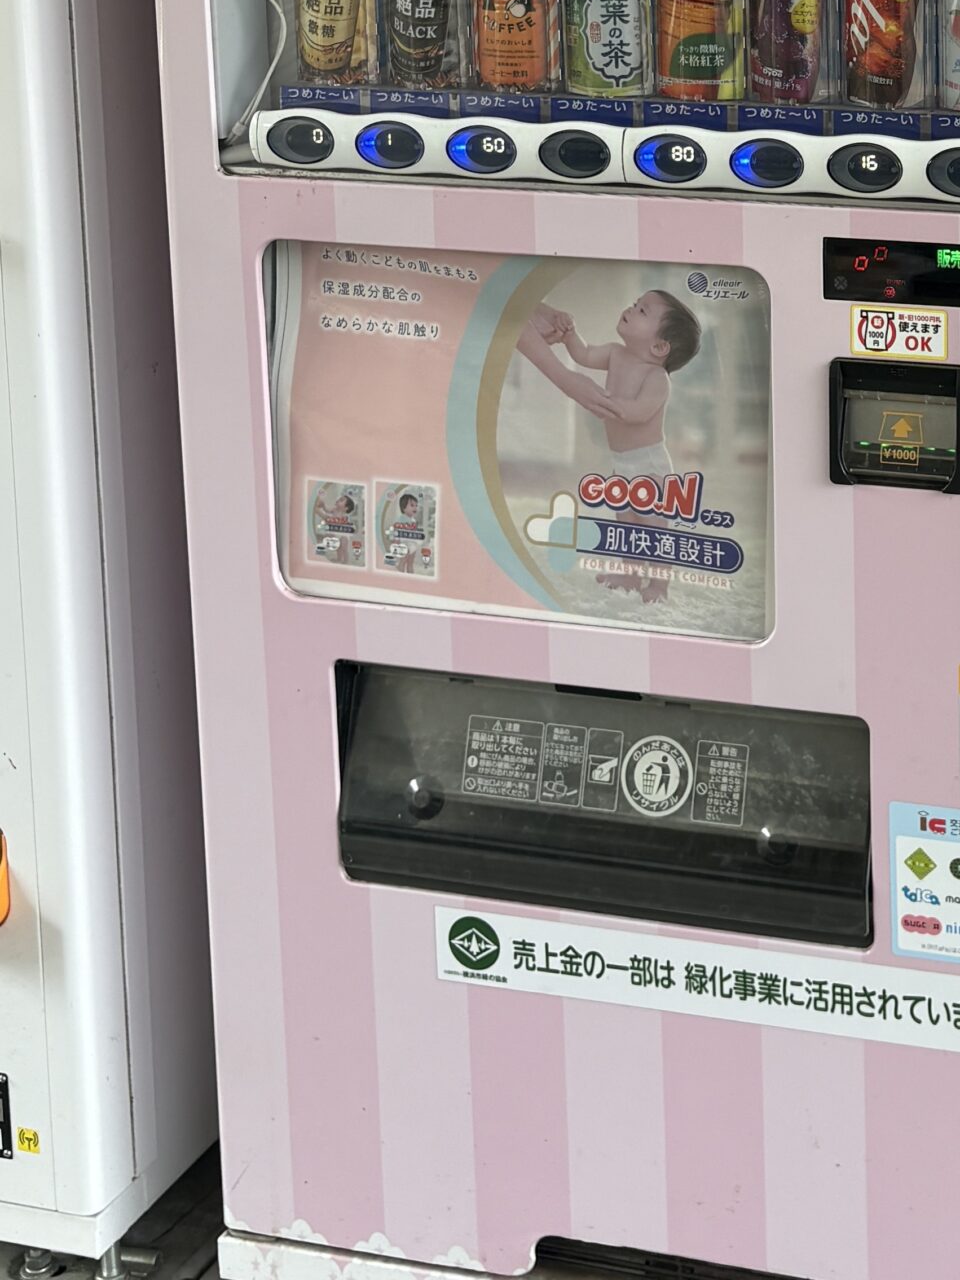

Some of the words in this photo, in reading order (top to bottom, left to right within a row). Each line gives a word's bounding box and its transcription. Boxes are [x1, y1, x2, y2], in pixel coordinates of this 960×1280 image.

[394, 17, 437, 38] BLACK
[678, 54, 725, 67] 本格紅茶
[321, 247, 479, 282] よく動くこどもの肌をまもる
[321, 280, 422, 302] 保湿成分配合の
[703, 289, 749, 301] エリエール
[320, 314, 440, 339] なめらかな肌触り
[899, 322, 941, 334] 使えます
[905, 336, 932, 352] OK
[883, 448, 916, 461] ¥1000
[605, 527, 725, 567] 肌快適設計
[512, 937, 675, 990] 売上金の一部は
